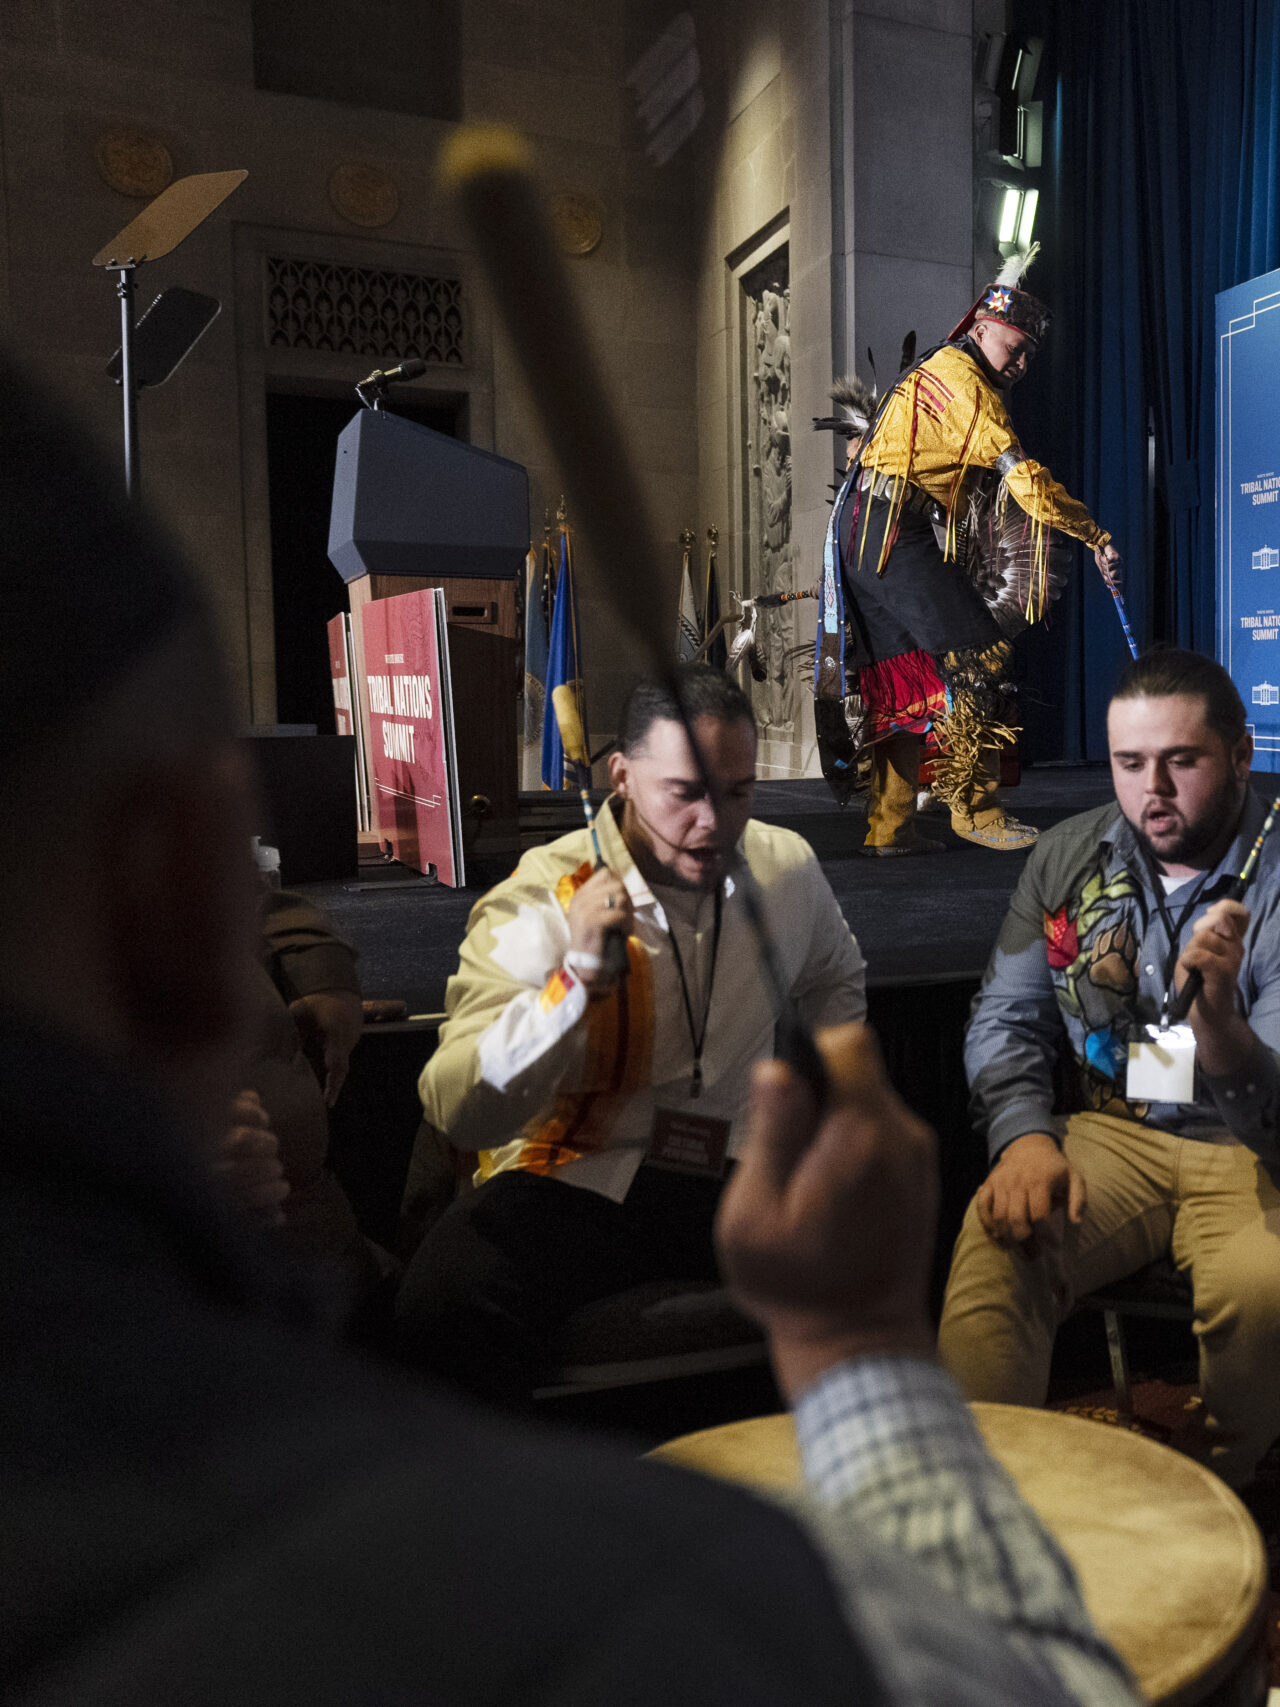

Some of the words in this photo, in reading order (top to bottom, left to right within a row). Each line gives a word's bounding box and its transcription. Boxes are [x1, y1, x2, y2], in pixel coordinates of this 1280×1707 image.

[1240, 481, 1262, 495] TRIBAL
[1252, 490, 1279, 506] SUMMIT
[1240, 616, 1262, 629] TRIBAL
[1252, 628, 1279, 641] SUMMIT
[367, 675, 394, 715] TRIBAL
[392, 674, 433, 720] NATIONS
[382, 720, 416, 764] SUMMIT
